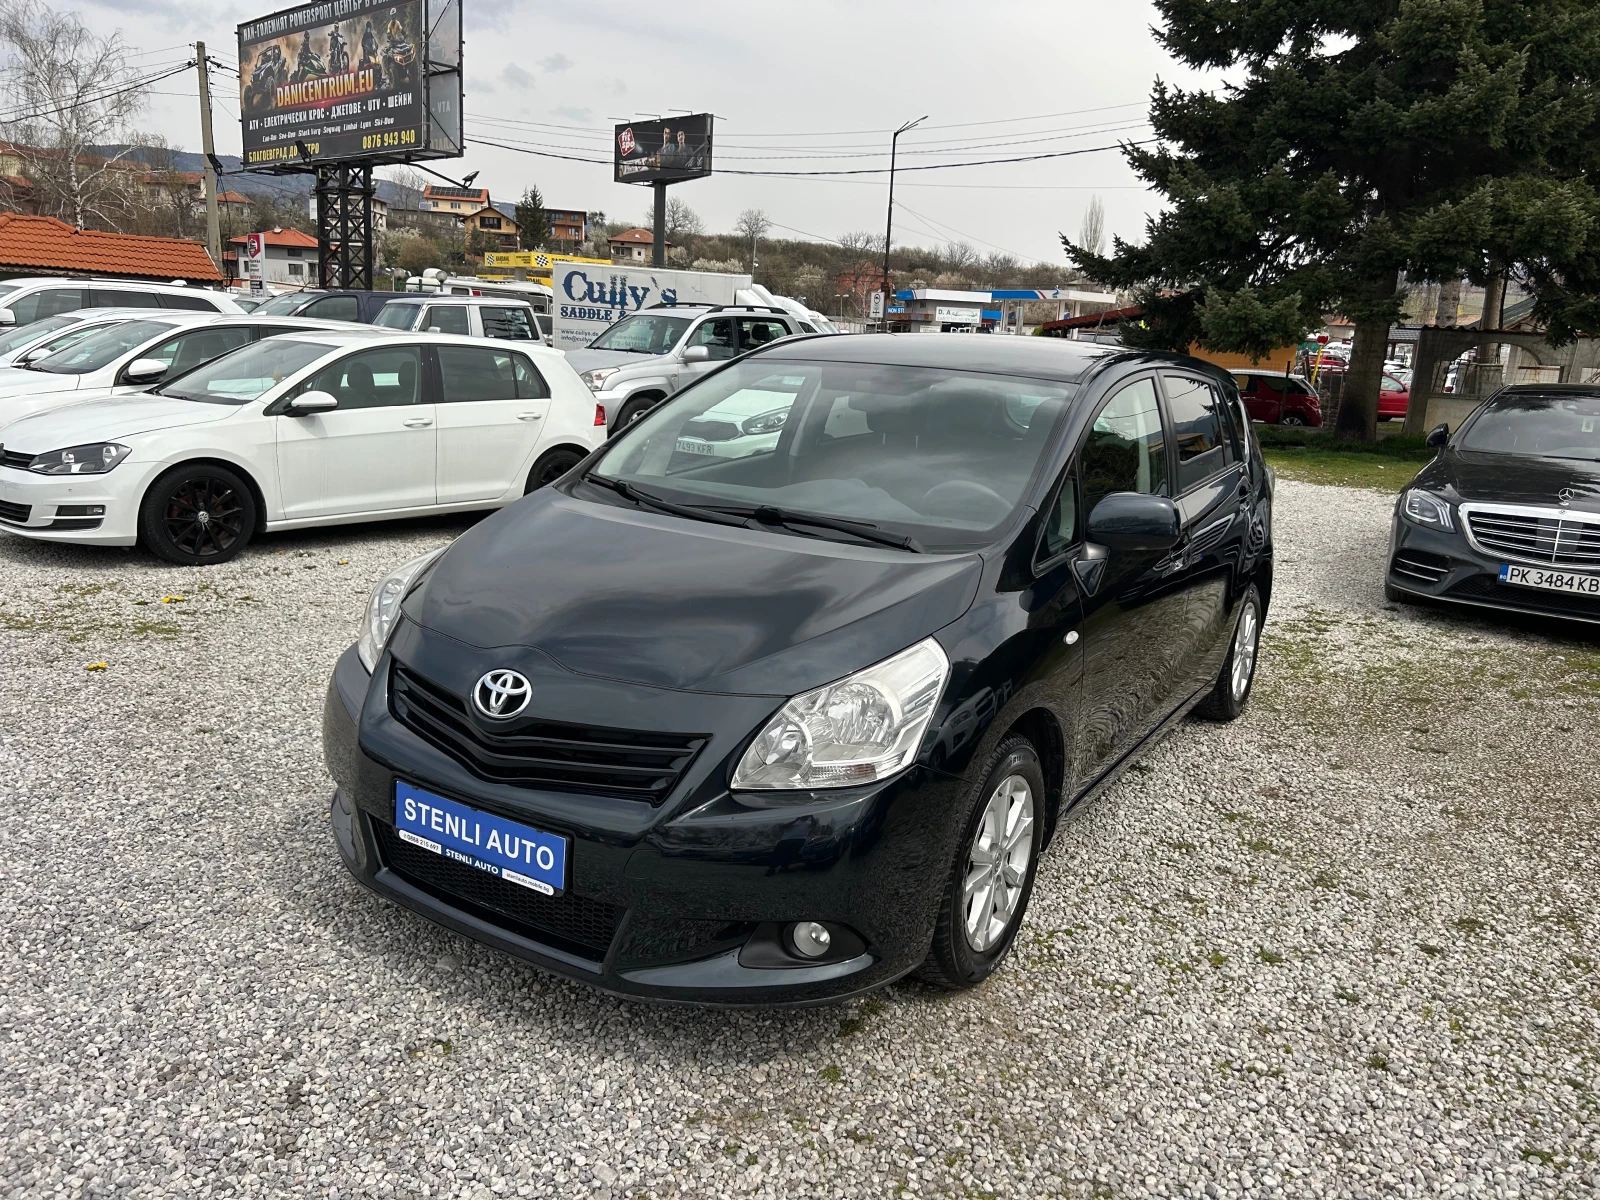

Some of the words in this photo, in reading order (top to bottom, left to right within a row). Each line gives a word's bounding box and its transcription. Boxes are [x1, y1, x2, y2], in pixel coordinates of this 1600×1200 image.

[243, 15, 288, 42] НАЙ-ГОЛЕМИЯТ
[289, 3, 333, 28] POWERSPORT
[276, 68, 374, 107] DANICENTRUM.EU
[249, 119, 259, 130] ATV
[264, 110, 307, 128] ЕЛЕКТРИЧЕСКИ
[308, 108, 325, 121] КРОС
[331, 102, 362, 119] ДЖЕТОВЕ
[368, 98, 381, 112] UTV
[388, 92, 413, 108] ШЕЙНИ
[362, 135, 382, 149] 0876
[384, 132, 399, 146] 943
[401, 130, 416, 144] 940
[248, 147, 288, 162] БЛАГОЕВГРАД
[560, 306, 613, 320] SADDLE
[677, 440, 695, 452] 7493
[697, 444, 712, 455] KFR
[1509, 567, 1531, 584] PK
[1533, 571, 1574, 590] 3484
[1576, 577, 1600, 593] KB
[404, 798, 480, 845] STENLI
[485, 829, 555, 870] AUTO
[445, 849, 472, 864] STENLI
[474, 860, 499, 874] AUTO
